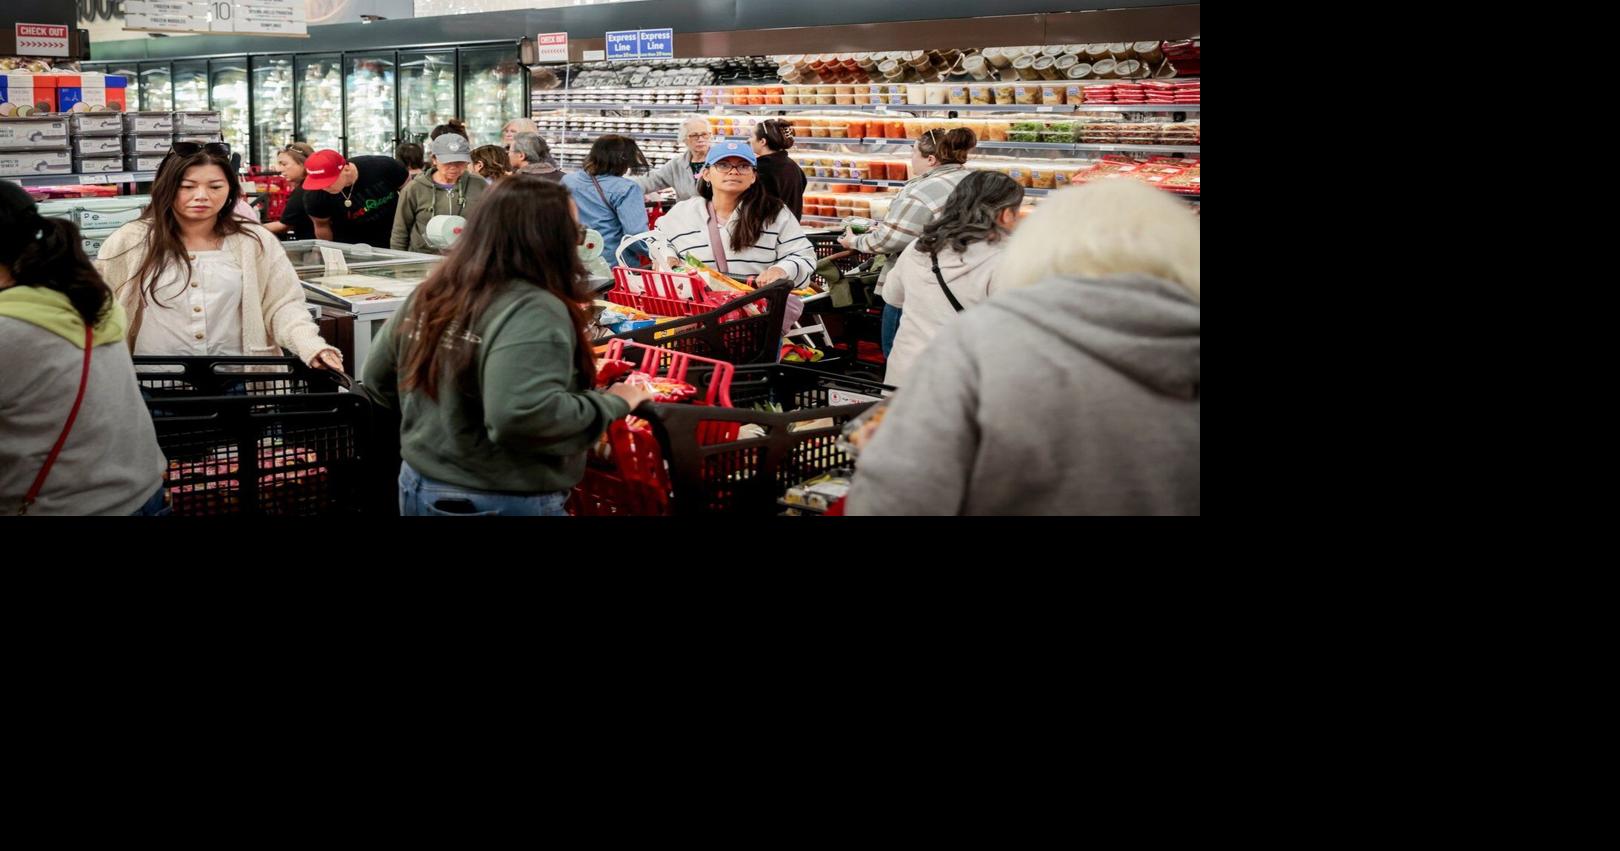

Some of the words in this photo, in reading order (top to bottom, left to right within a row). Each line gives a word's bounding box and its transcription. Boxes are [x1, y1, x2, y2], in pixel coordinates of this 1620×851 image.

[212, 2, 231, 20] 10
[20, 26, 47, 36] CHECK
[48, 28, 65, 37] OUT
[608, 34, 637, 43] Express
[640, 32, 671, 41] Express
[614, 43, 631, 52] Line
[647, 42, 664, 50] Line
